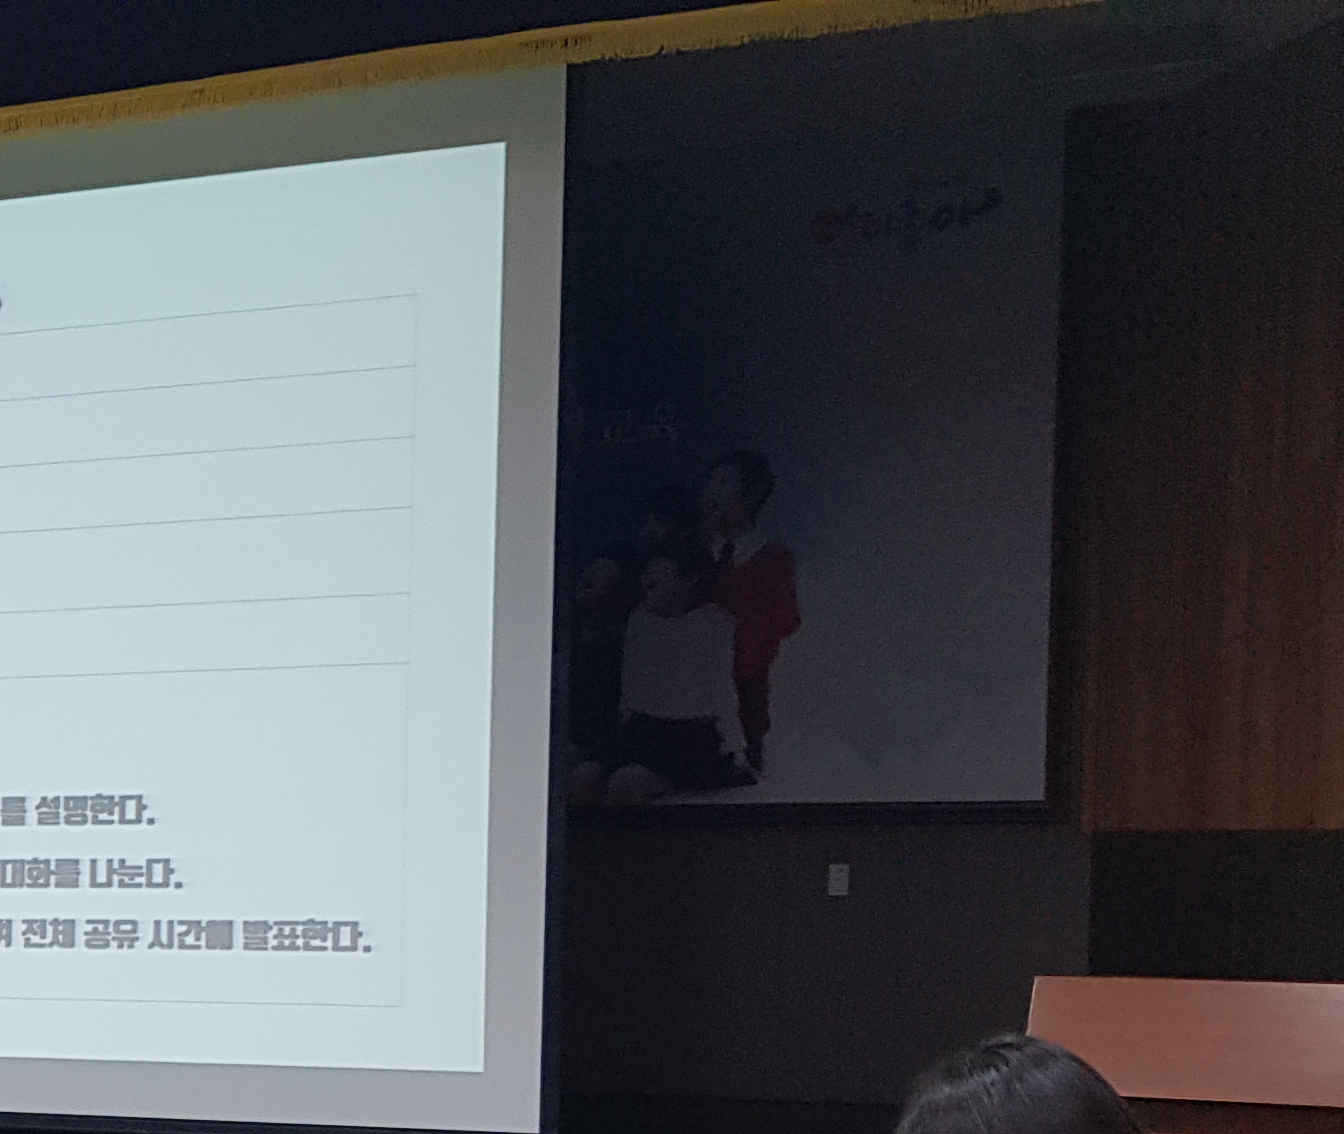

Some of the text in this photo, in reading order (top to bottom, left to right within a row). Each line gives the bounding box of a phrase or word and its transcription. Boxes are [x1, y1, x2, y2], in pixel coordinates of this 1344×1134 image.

[35, 793, 155, 826] 설명한다.
[0, 857, 82, 889] 대화를
[89, 858, 183, 889] 나눈다.
[21, 918, 76, 948] 전체
[83, 919, 140, 949] 공유
[242, 918, 372, 953] 발표한다.
